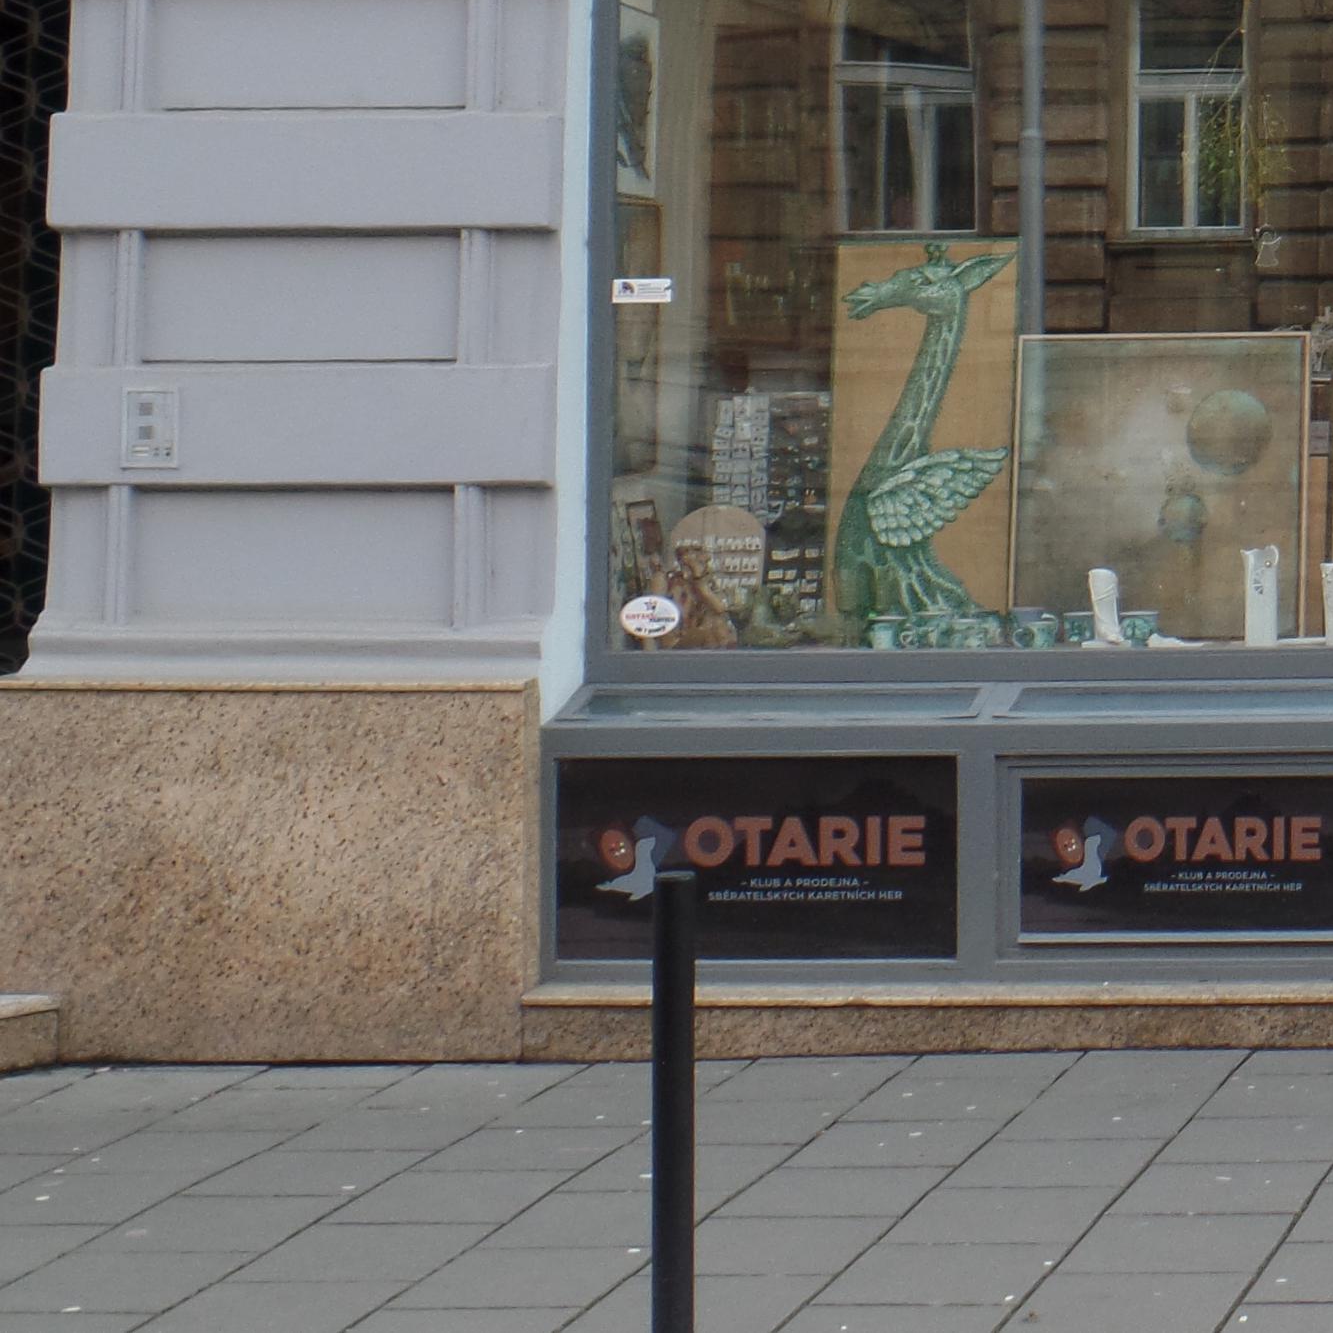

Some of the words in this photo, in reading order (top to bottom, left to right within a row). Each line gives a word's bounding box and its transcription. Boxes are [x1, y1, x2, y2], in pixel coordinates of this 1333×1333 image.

[684, 815, 926, 867] OTARIE
[1123, 815, 1323, 863] OTARIE
[1177, 871, 1204, 880] KLUB
[1205, 871, 1212, 880] A
[749, 877, 781, 888] KLUB
[783, 877, 793, 888] A
[795, 877, 860, 888] PRODEJNA
[807, 888, 876, 900] KARETNÍCH
[878, 889, 904, 900] HER
